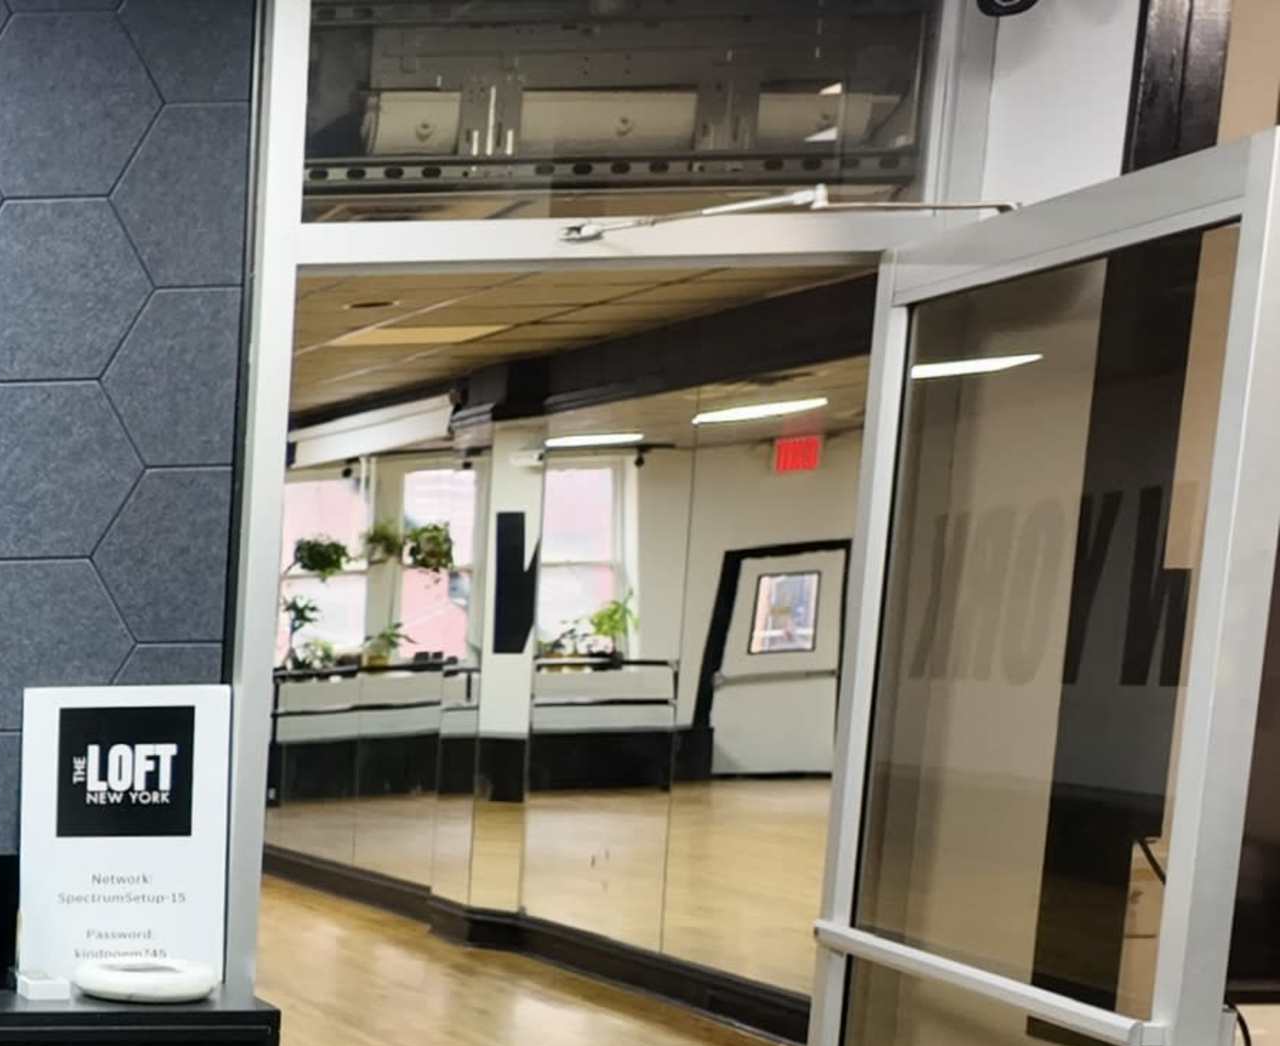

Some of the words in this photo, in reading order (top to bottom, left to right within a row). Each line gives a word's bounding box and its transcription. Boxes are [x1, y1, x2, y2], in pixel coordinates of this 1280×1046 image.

[72, 756, 87, 784] THE
[86, 743, 178, 792] LOFT
[86, 790, 124, 805] NEW
[129, 790, 171, 804] YORK
